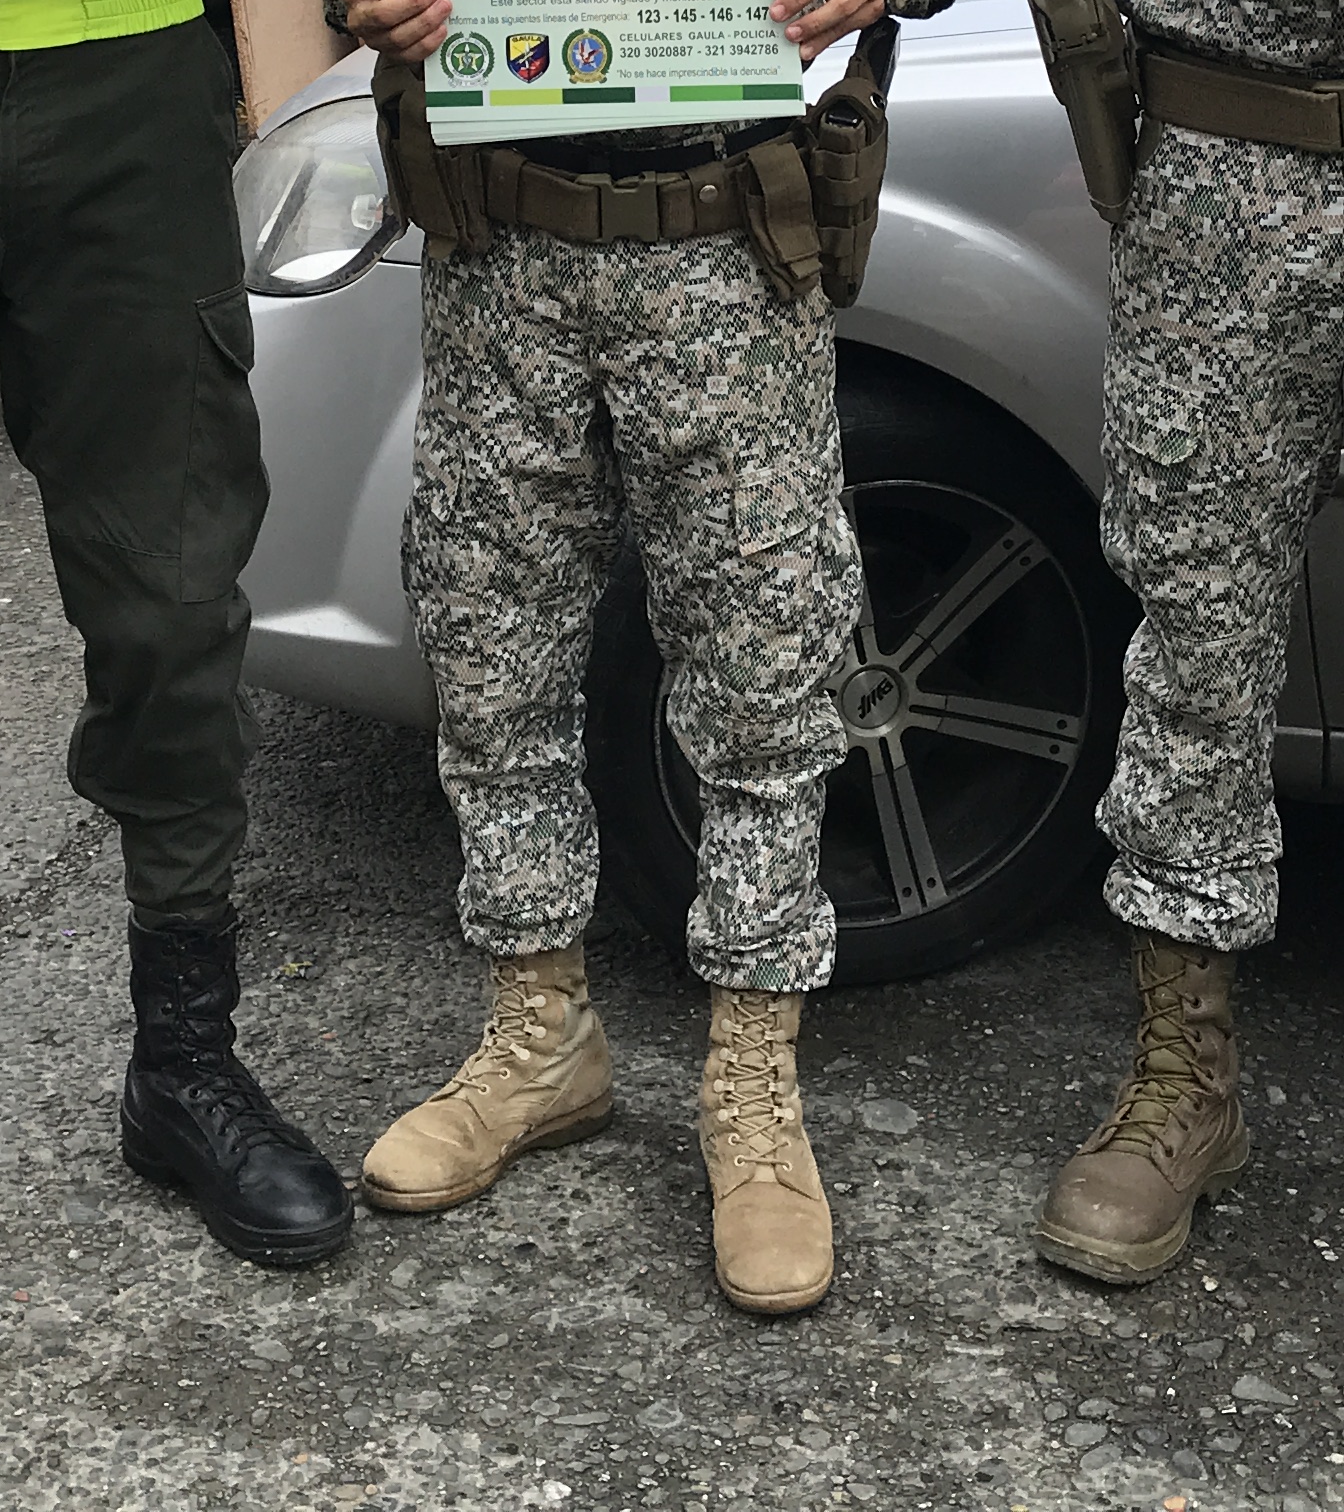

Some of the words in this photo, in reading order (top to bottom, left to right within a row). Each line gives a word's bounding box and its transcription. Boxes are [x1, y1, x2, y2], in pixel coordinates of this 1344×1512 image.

[636, 9, 660, 24] 123
[672, 8, 696, 23] 145
[709, 7, 733, 22] 146
[745, 6, 769, 21] 147
